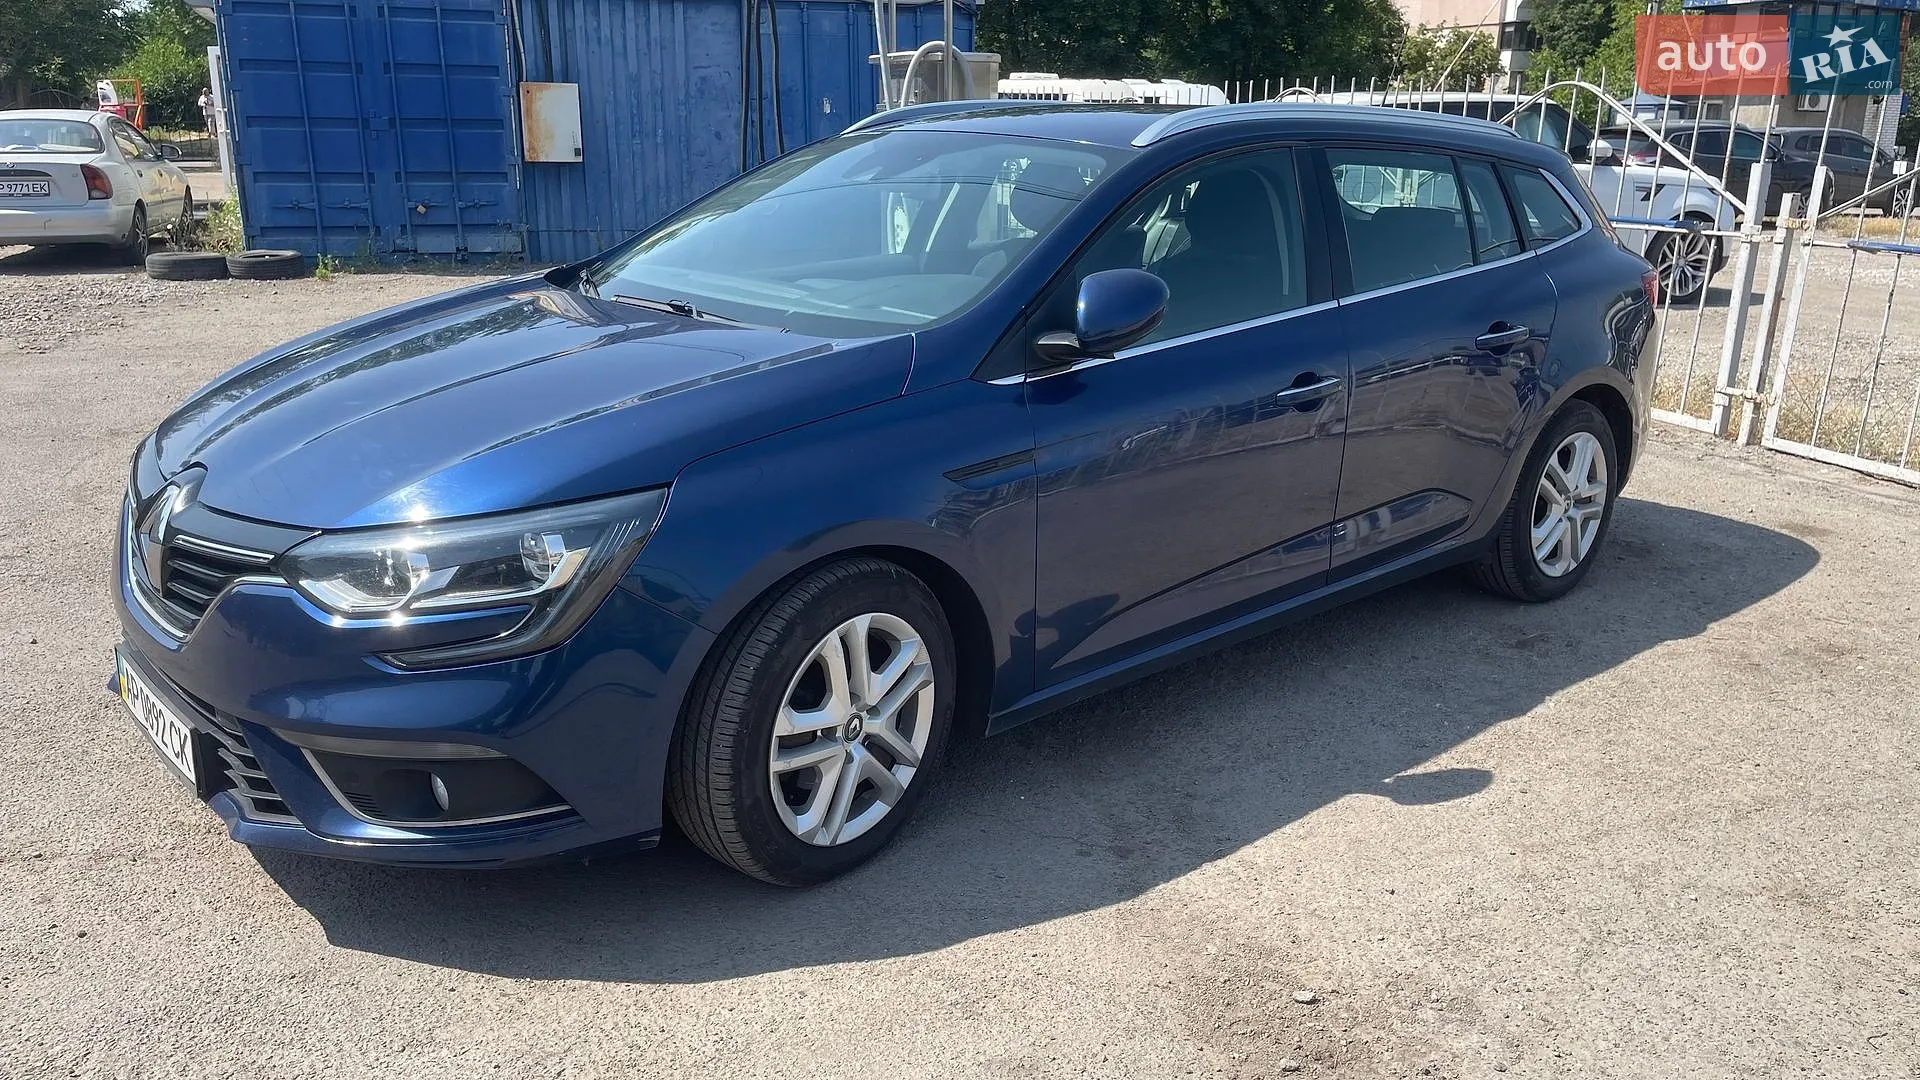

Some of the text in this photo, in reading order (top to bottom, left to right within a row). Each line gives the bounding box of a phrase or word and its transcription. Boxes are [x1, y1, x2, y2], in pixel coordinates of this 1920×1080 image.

[7, 183, 30, 193] 9771
[32, 183, 48, 193] EK
[169, 720, 192, 773] CK
